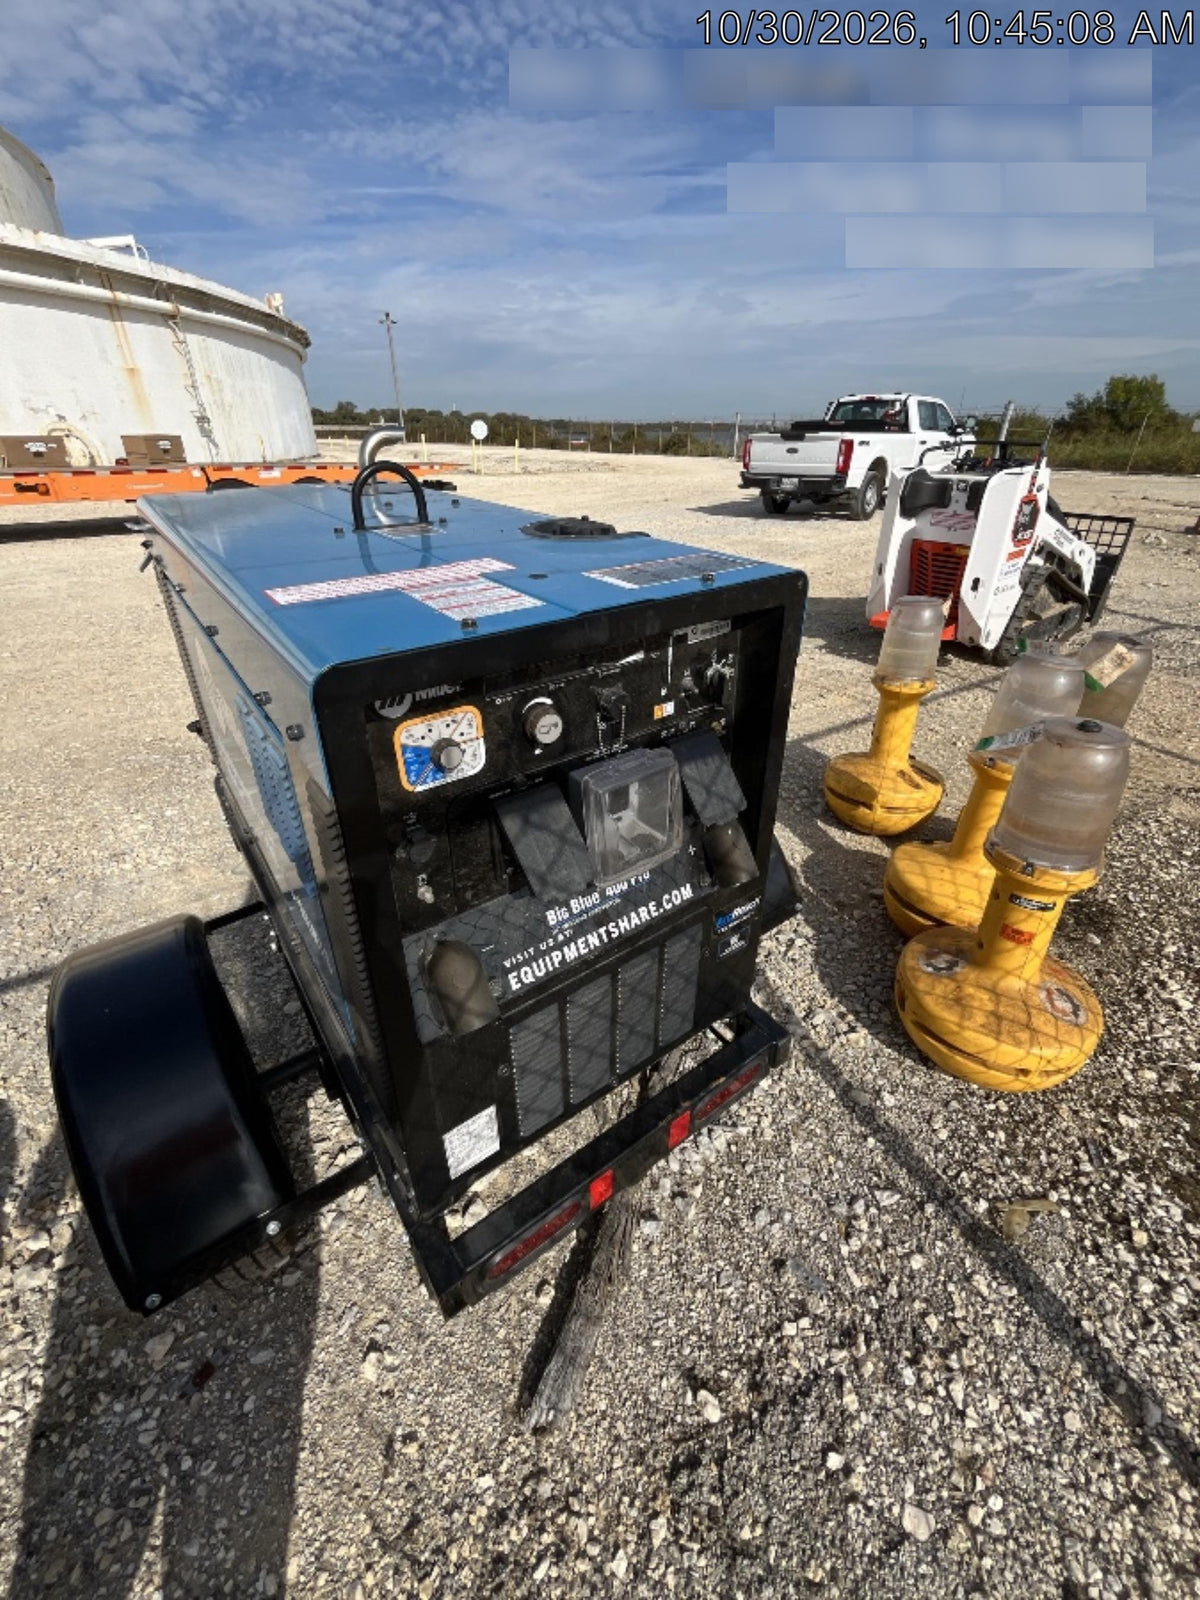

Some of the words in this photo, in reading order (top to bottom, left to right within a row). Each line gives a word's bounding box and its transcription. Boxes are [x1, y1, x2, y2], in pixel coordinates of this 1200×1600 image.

[503, 947, 535, 969] VISIT
[539, 938, 554, 951] US
[507, 883, 695, 991] EQUIPMENTSHARE.COM
